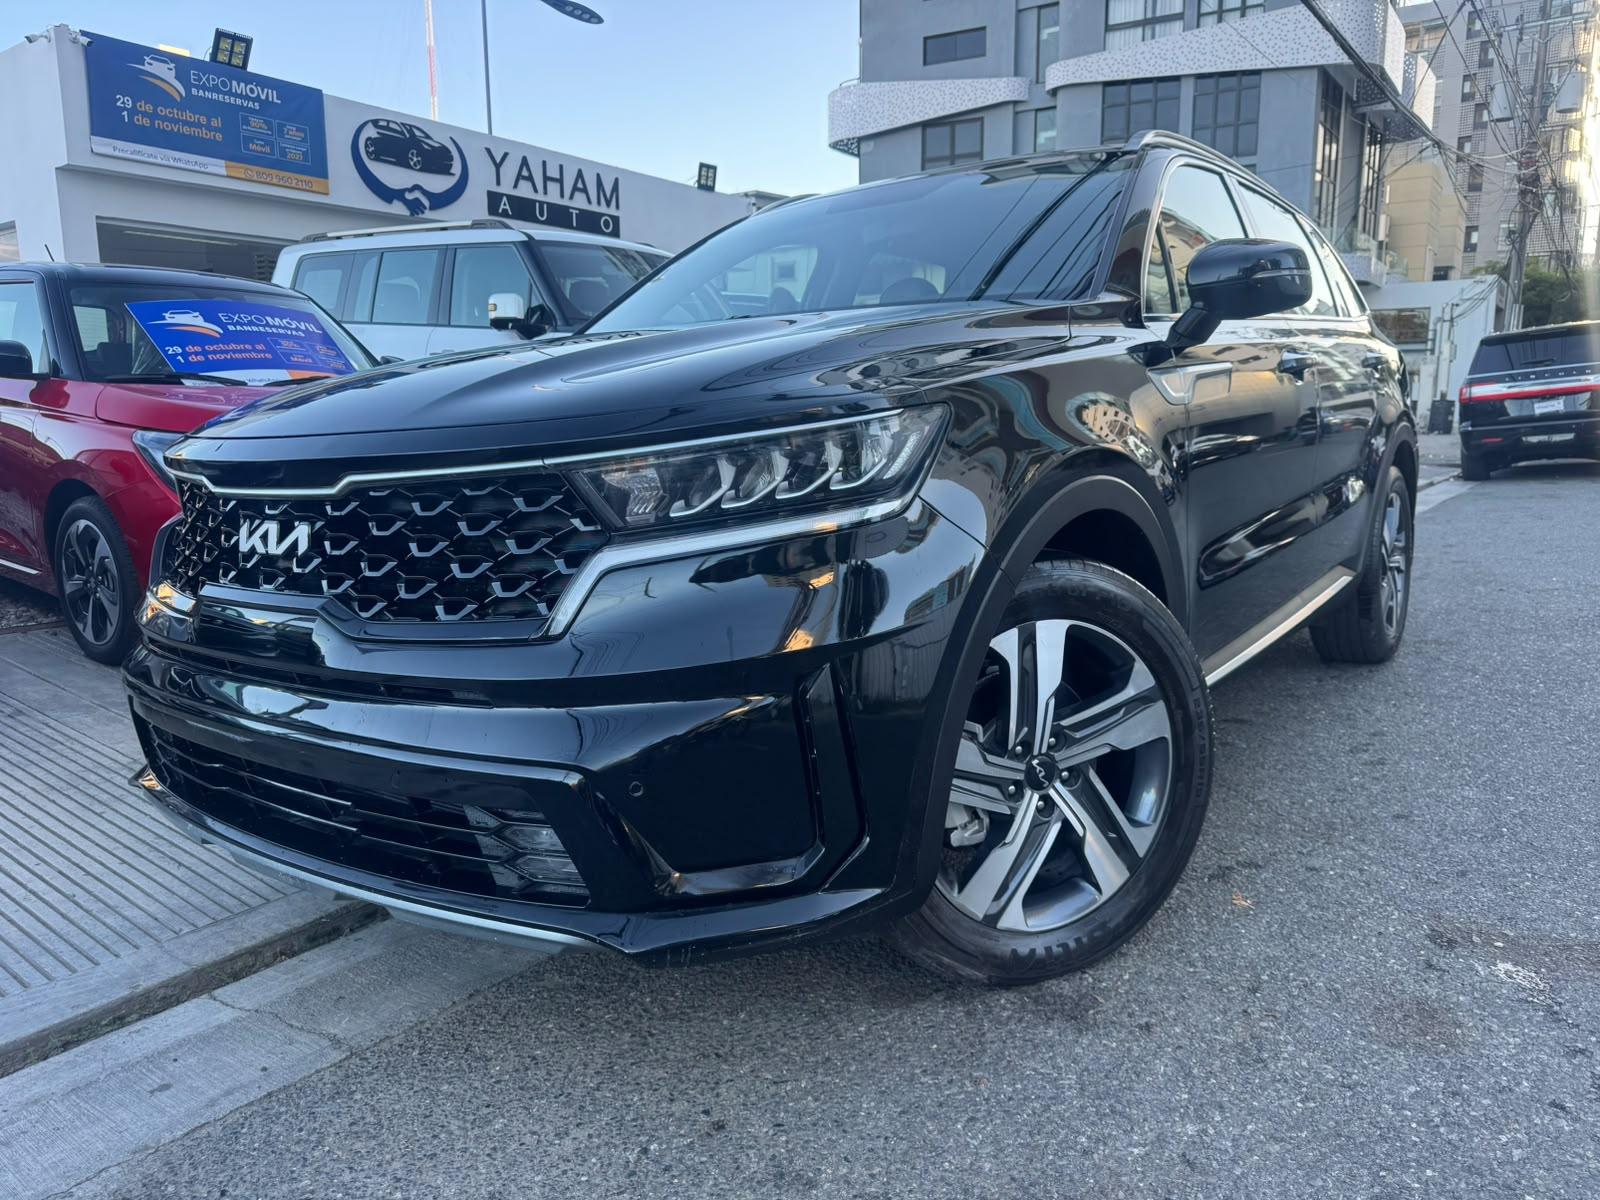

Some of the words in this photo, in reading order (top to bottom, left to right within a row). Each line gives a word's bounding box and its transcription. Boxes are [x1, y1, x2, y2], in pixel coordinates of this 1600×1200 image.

[191, 70, 281, 104] EXPOMÓVIL
[191, 88, 260, 110] BANRESERVAS
[116, 94, 132, 109] 29
[136, 100, 153, 113] de
[157, 105, 207, 125] octubre
[211, 117, 222, 128] al
[122, 111, 128, 122] 1
[134, 113, 151, 127] de
[155, 119, 223, 142] noviembre
[255, 170, 273, 182] 809
[293, 176, 314, 190] 2110
[484, 146, 620, 211] YAHAM
[498, 195, 614, 233] AUTO
[227, 324, 306, 337] BANRESERVAS
[165, 346, 182, 355] 29
[204, 343, 253, 352] octubre
[176, 355, 185, 363] 1
[188, 354, 205, 362] de
[207, 351, 273, 361] noviembre
[238, 519, 310, 557] KIA
